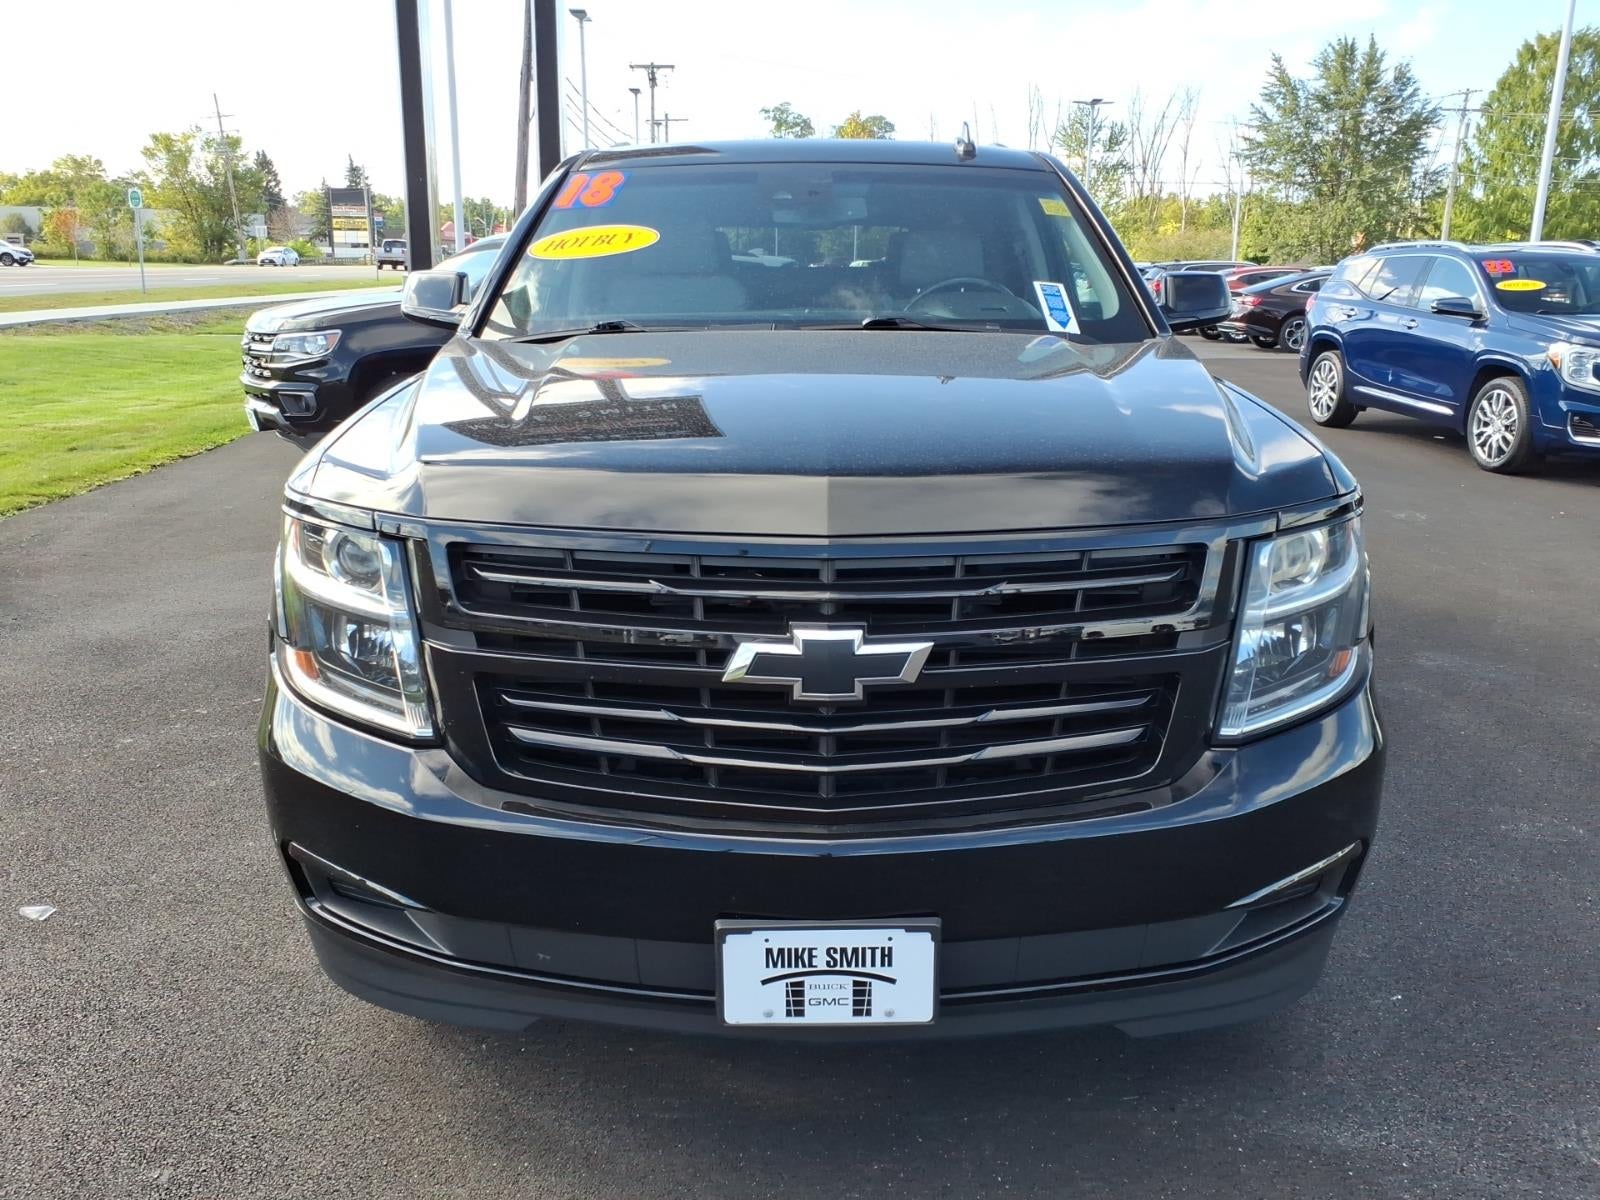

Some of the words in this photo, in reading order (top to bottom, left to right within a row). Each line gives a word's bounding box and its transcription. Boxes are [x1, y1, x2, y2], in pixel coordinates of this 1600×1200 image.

[555, 171, 624, 208] 18
[543, 236, 589, 252] HOT
[592, 232, 642, 247] BUY
[765, 947, 818, 968] MIKE
[825, 946, 893, 968] SMITH
[808, 997, 849, 1006] GMC
